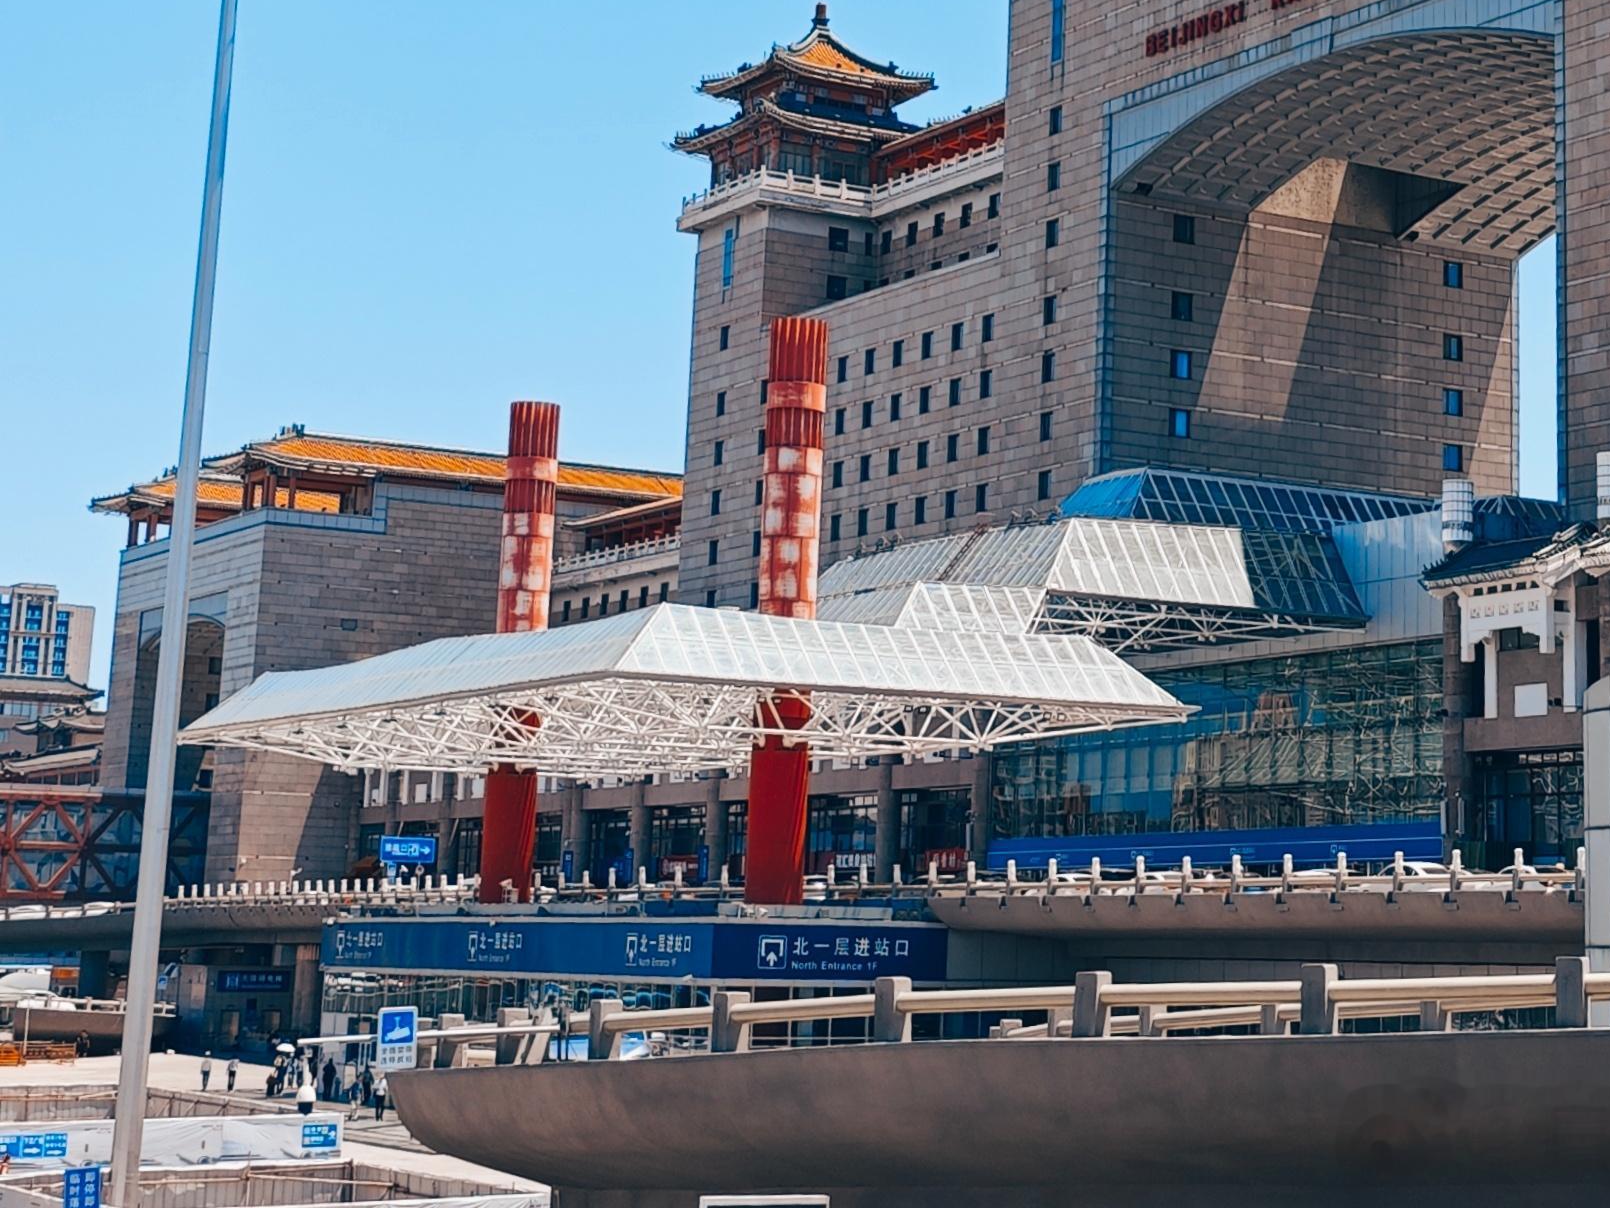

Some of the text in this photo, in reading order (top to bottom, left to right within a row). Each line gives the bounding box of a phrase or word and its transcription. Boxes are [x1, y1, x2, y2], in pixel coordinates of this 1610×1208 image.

[1146, 0, 1245, 58] BEIJINGXI
[640, 934, 692, 953] 北一层进站口
[793, 937, 909, 957] 北一层进站口
[791, 961, 878, 971] North Entrance 1F
